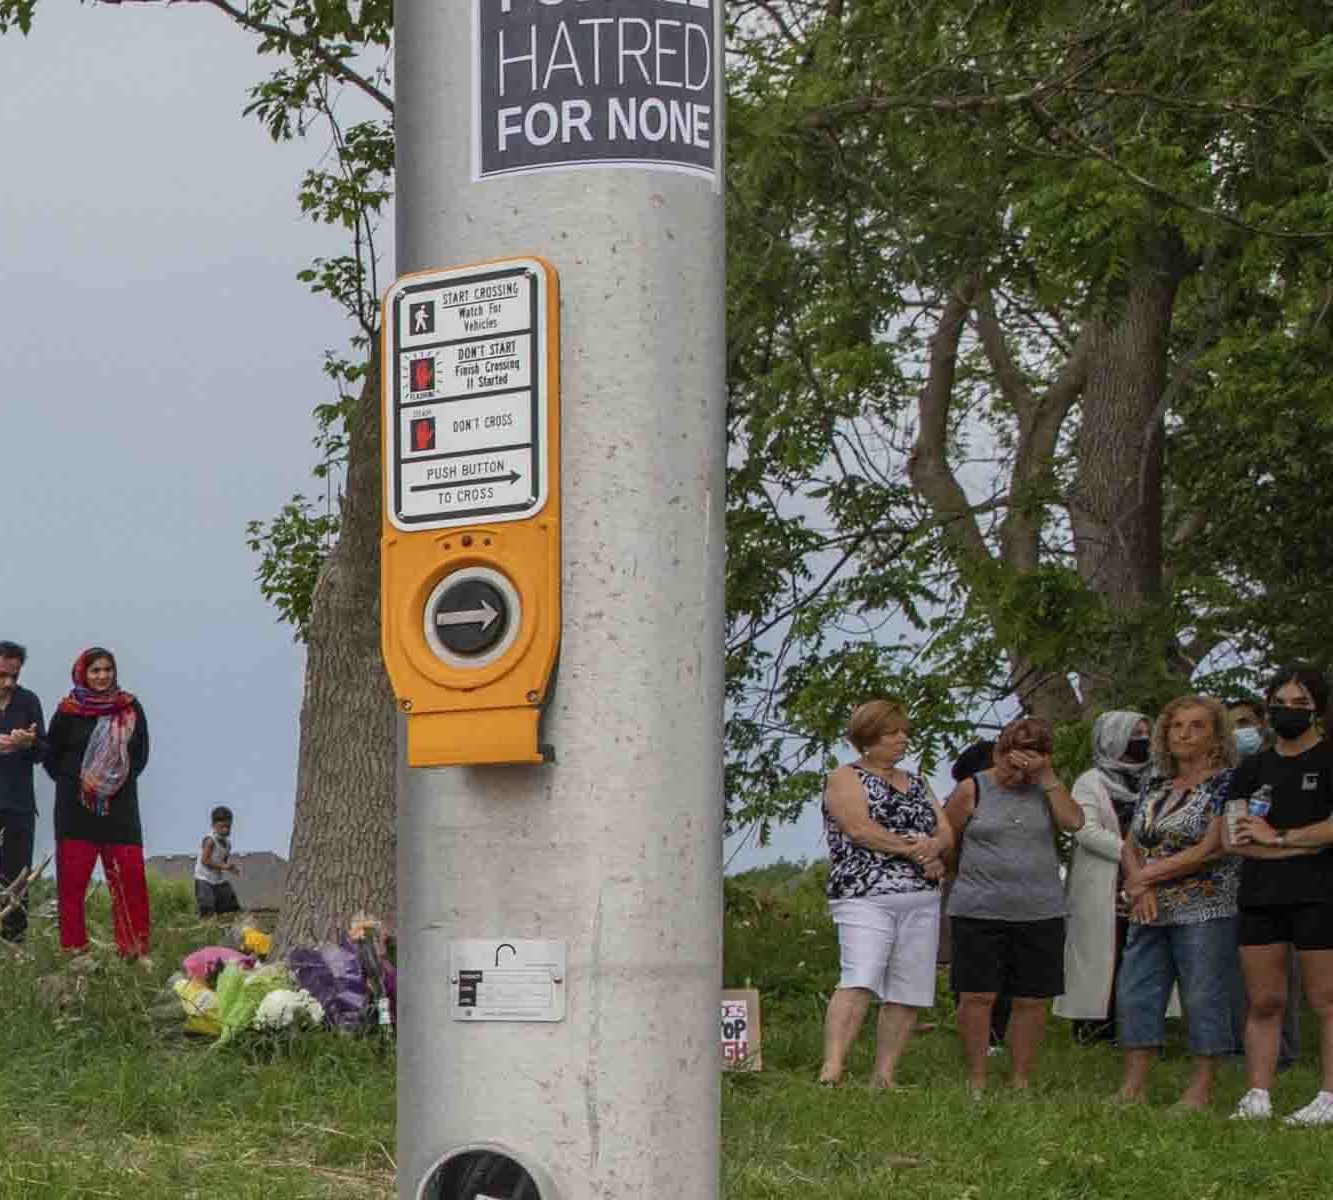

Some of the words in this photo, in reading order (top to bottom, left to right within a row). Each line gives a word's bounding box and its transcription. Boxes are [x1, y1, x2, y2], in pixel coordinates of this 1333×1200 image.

[499, 17, 710, 96] HATRED
[497, 99, 593, 151] FOR
[607, 97, 711, 149] NONE
[442, 289, 470, 305] START
[474, 281, 518, 299] CROSSING
[459, 306, 483, 320] Watch
[489, 302, 501, 313] For
[464, 319, 497, 332] Vehicles
[458, 345, 484, 360] DON'T
[489, 341, 516, 355] START
[455, 363, 479, 377] Finish
[485, 359, 520, 371] Crossing
[478, 373, 508, 388] Started
[453, 417, 479, 433] DON'T
[484, 413, 513, 429] CROSS
[427, 466, 457, 480] PUSH
[461, 460, 505, 476] BUTTON
[437, 491, 452, 505] TO
[456, 487, 494, 503] CROSS
